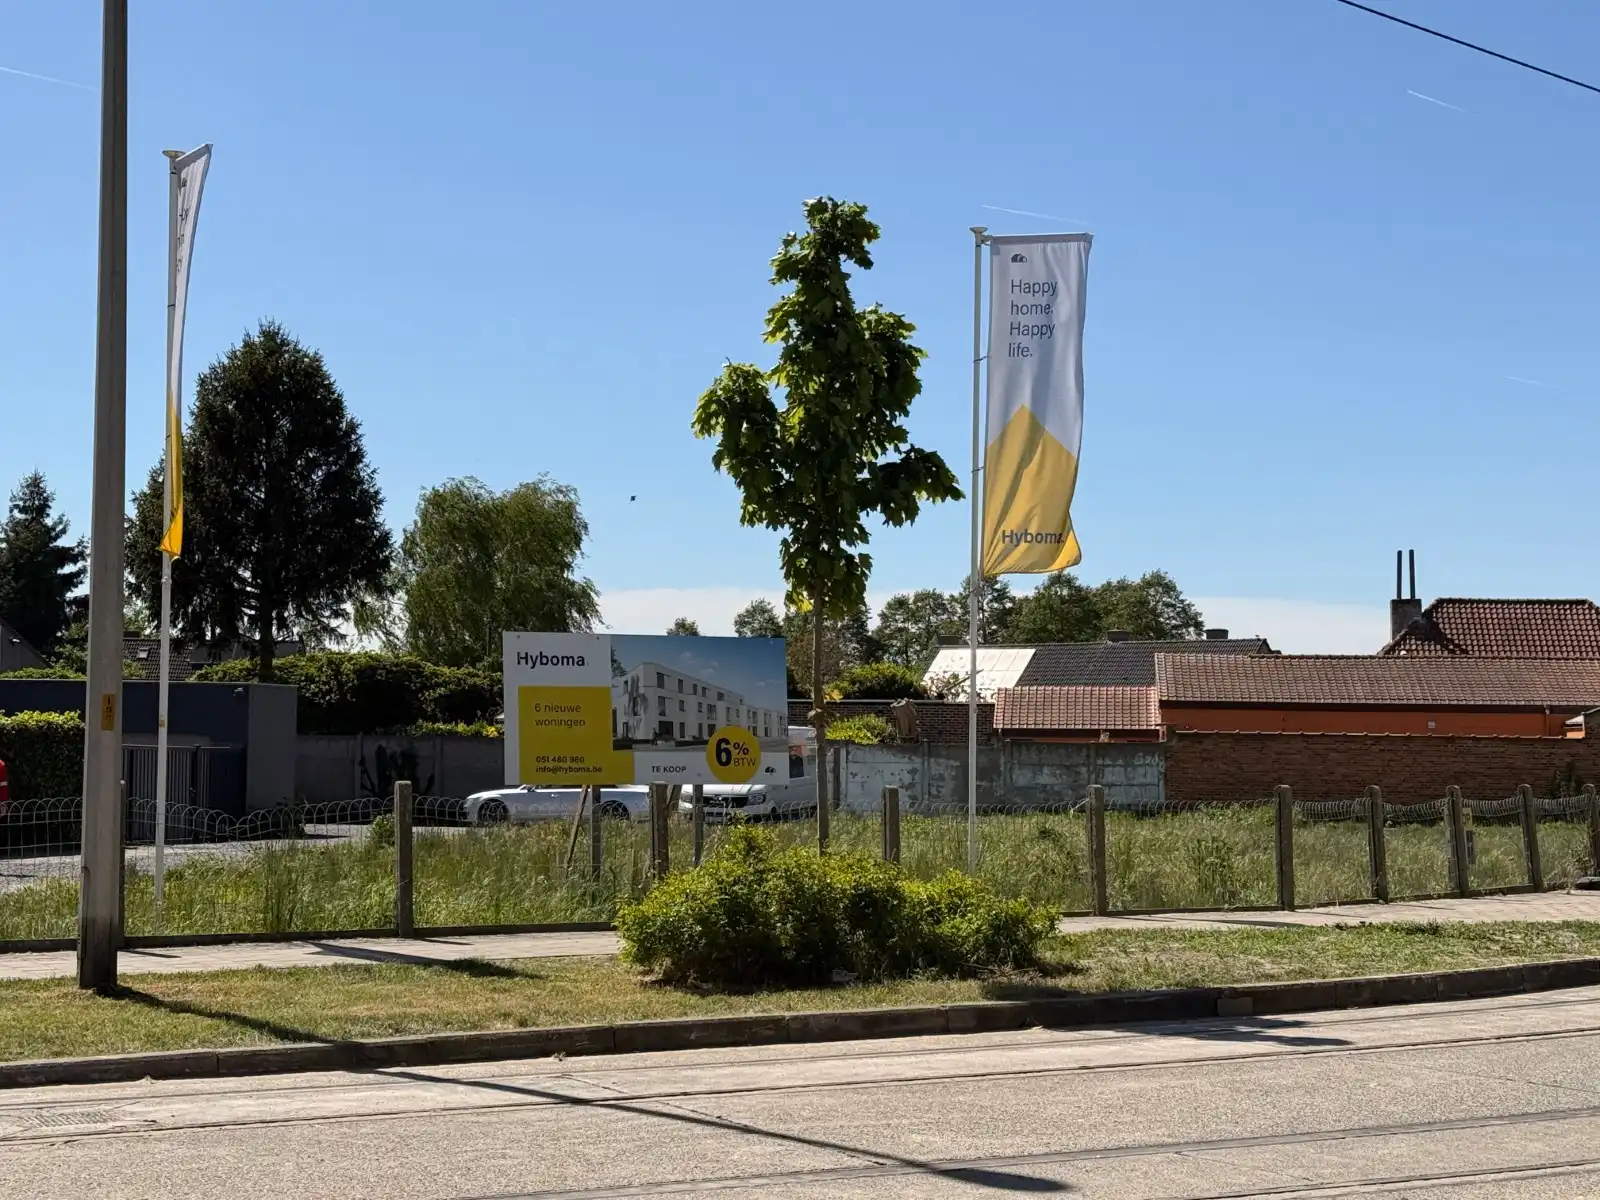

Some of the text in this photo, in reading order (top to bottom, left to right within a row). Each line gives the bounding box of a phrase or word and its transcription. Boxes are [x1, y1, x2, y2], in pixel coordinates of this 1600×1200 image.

[1011, 279, 1057, 297] Happy
[1010, 300, 1053, 315] home.
[1009, 321, 1056, 339] Happy
[1008, 342, 1033, 357] life.
[516, 651, 586, 669] Hyboma
[534, 703, 581, 712] 6 nieuwe
[535, 717, 586, 728] woningen
[535, 755, 550, 763] 051
[733, 758, 756, 767] BTW
[535, 765, 603, 775] info@hyboma.be
